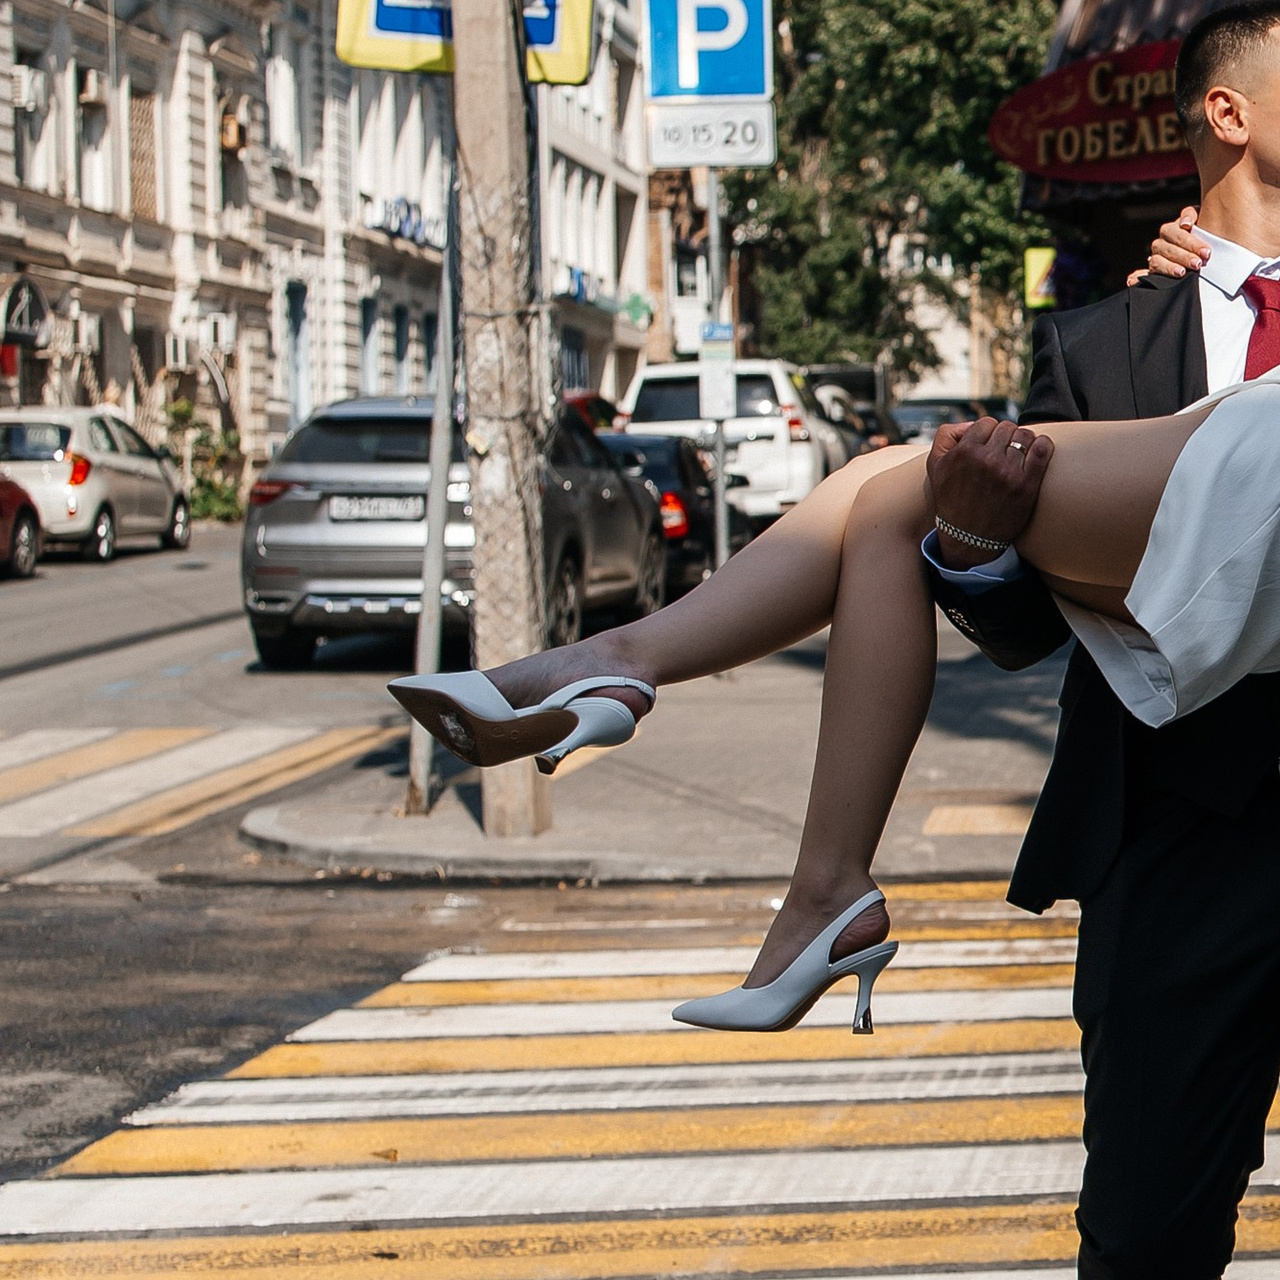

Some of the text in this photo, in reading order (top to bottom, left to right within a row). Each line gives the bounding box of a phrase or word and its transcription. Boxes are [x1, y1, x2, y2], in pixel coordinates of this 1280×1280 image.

[692, 123, 712, 142] 15
[723, 120, 757, 145] 20
[1038, 112, 1190, 166] ГОБЕЛЕ
